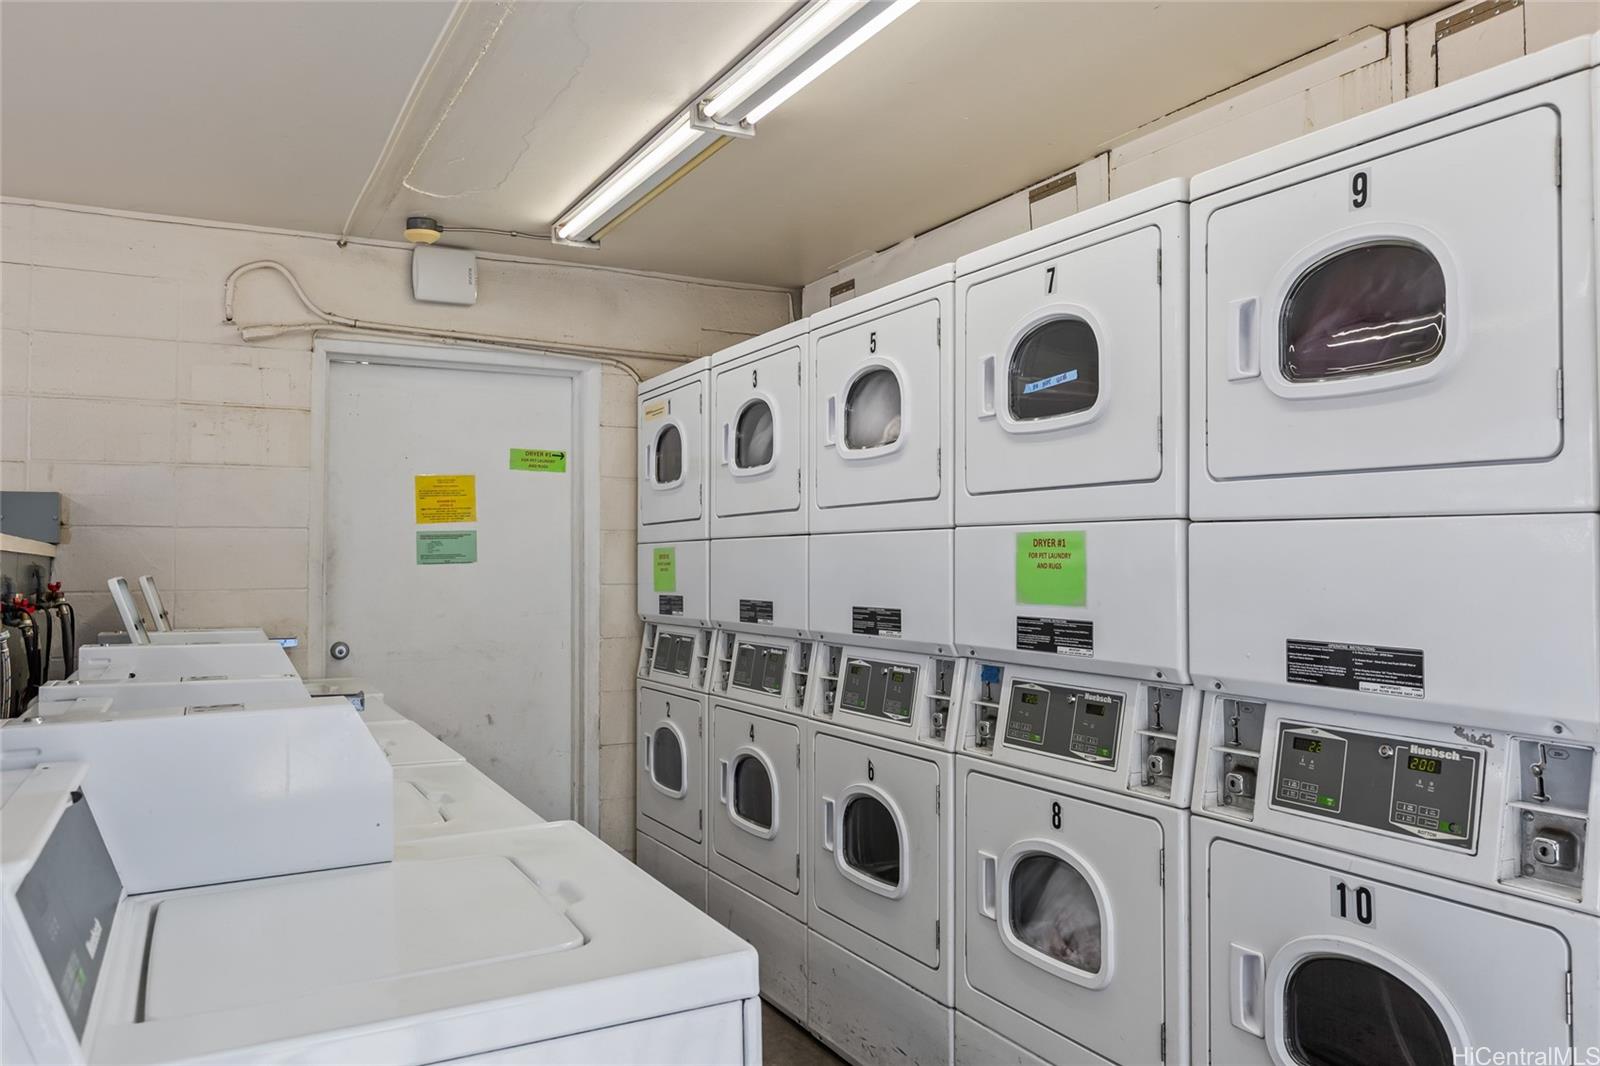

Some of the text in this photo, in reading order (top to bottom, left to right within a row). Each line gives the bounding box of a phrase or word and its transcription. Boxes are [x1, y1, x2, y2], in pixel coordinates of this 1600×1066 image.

[1352, 172, 1368, 209] 9
[1046, 267, 1056, 294] 7
[870, 332, 877, 354] 5
[752, 370, 759, 388] 3
[667, 399, 671, 415] 1
[1032, 538, 1066, 548] DRYER #1
[1048, 562, 1062, 570] RUGS
[1084, 692, 1112, 704] Huebsch
[665, 701, 671, 718] 2
[749, 723, 755, 742] 4
[1410, 744, 1460, 760] Huebsch
[867, 759, 875, 781] 6
[1410, 758, 1436, 772] 200
[1052, 801, 1062, 829] 8
[1417, 829, 1437, 838] BOTTOM
[1336, 882, 1372, 925] 10
